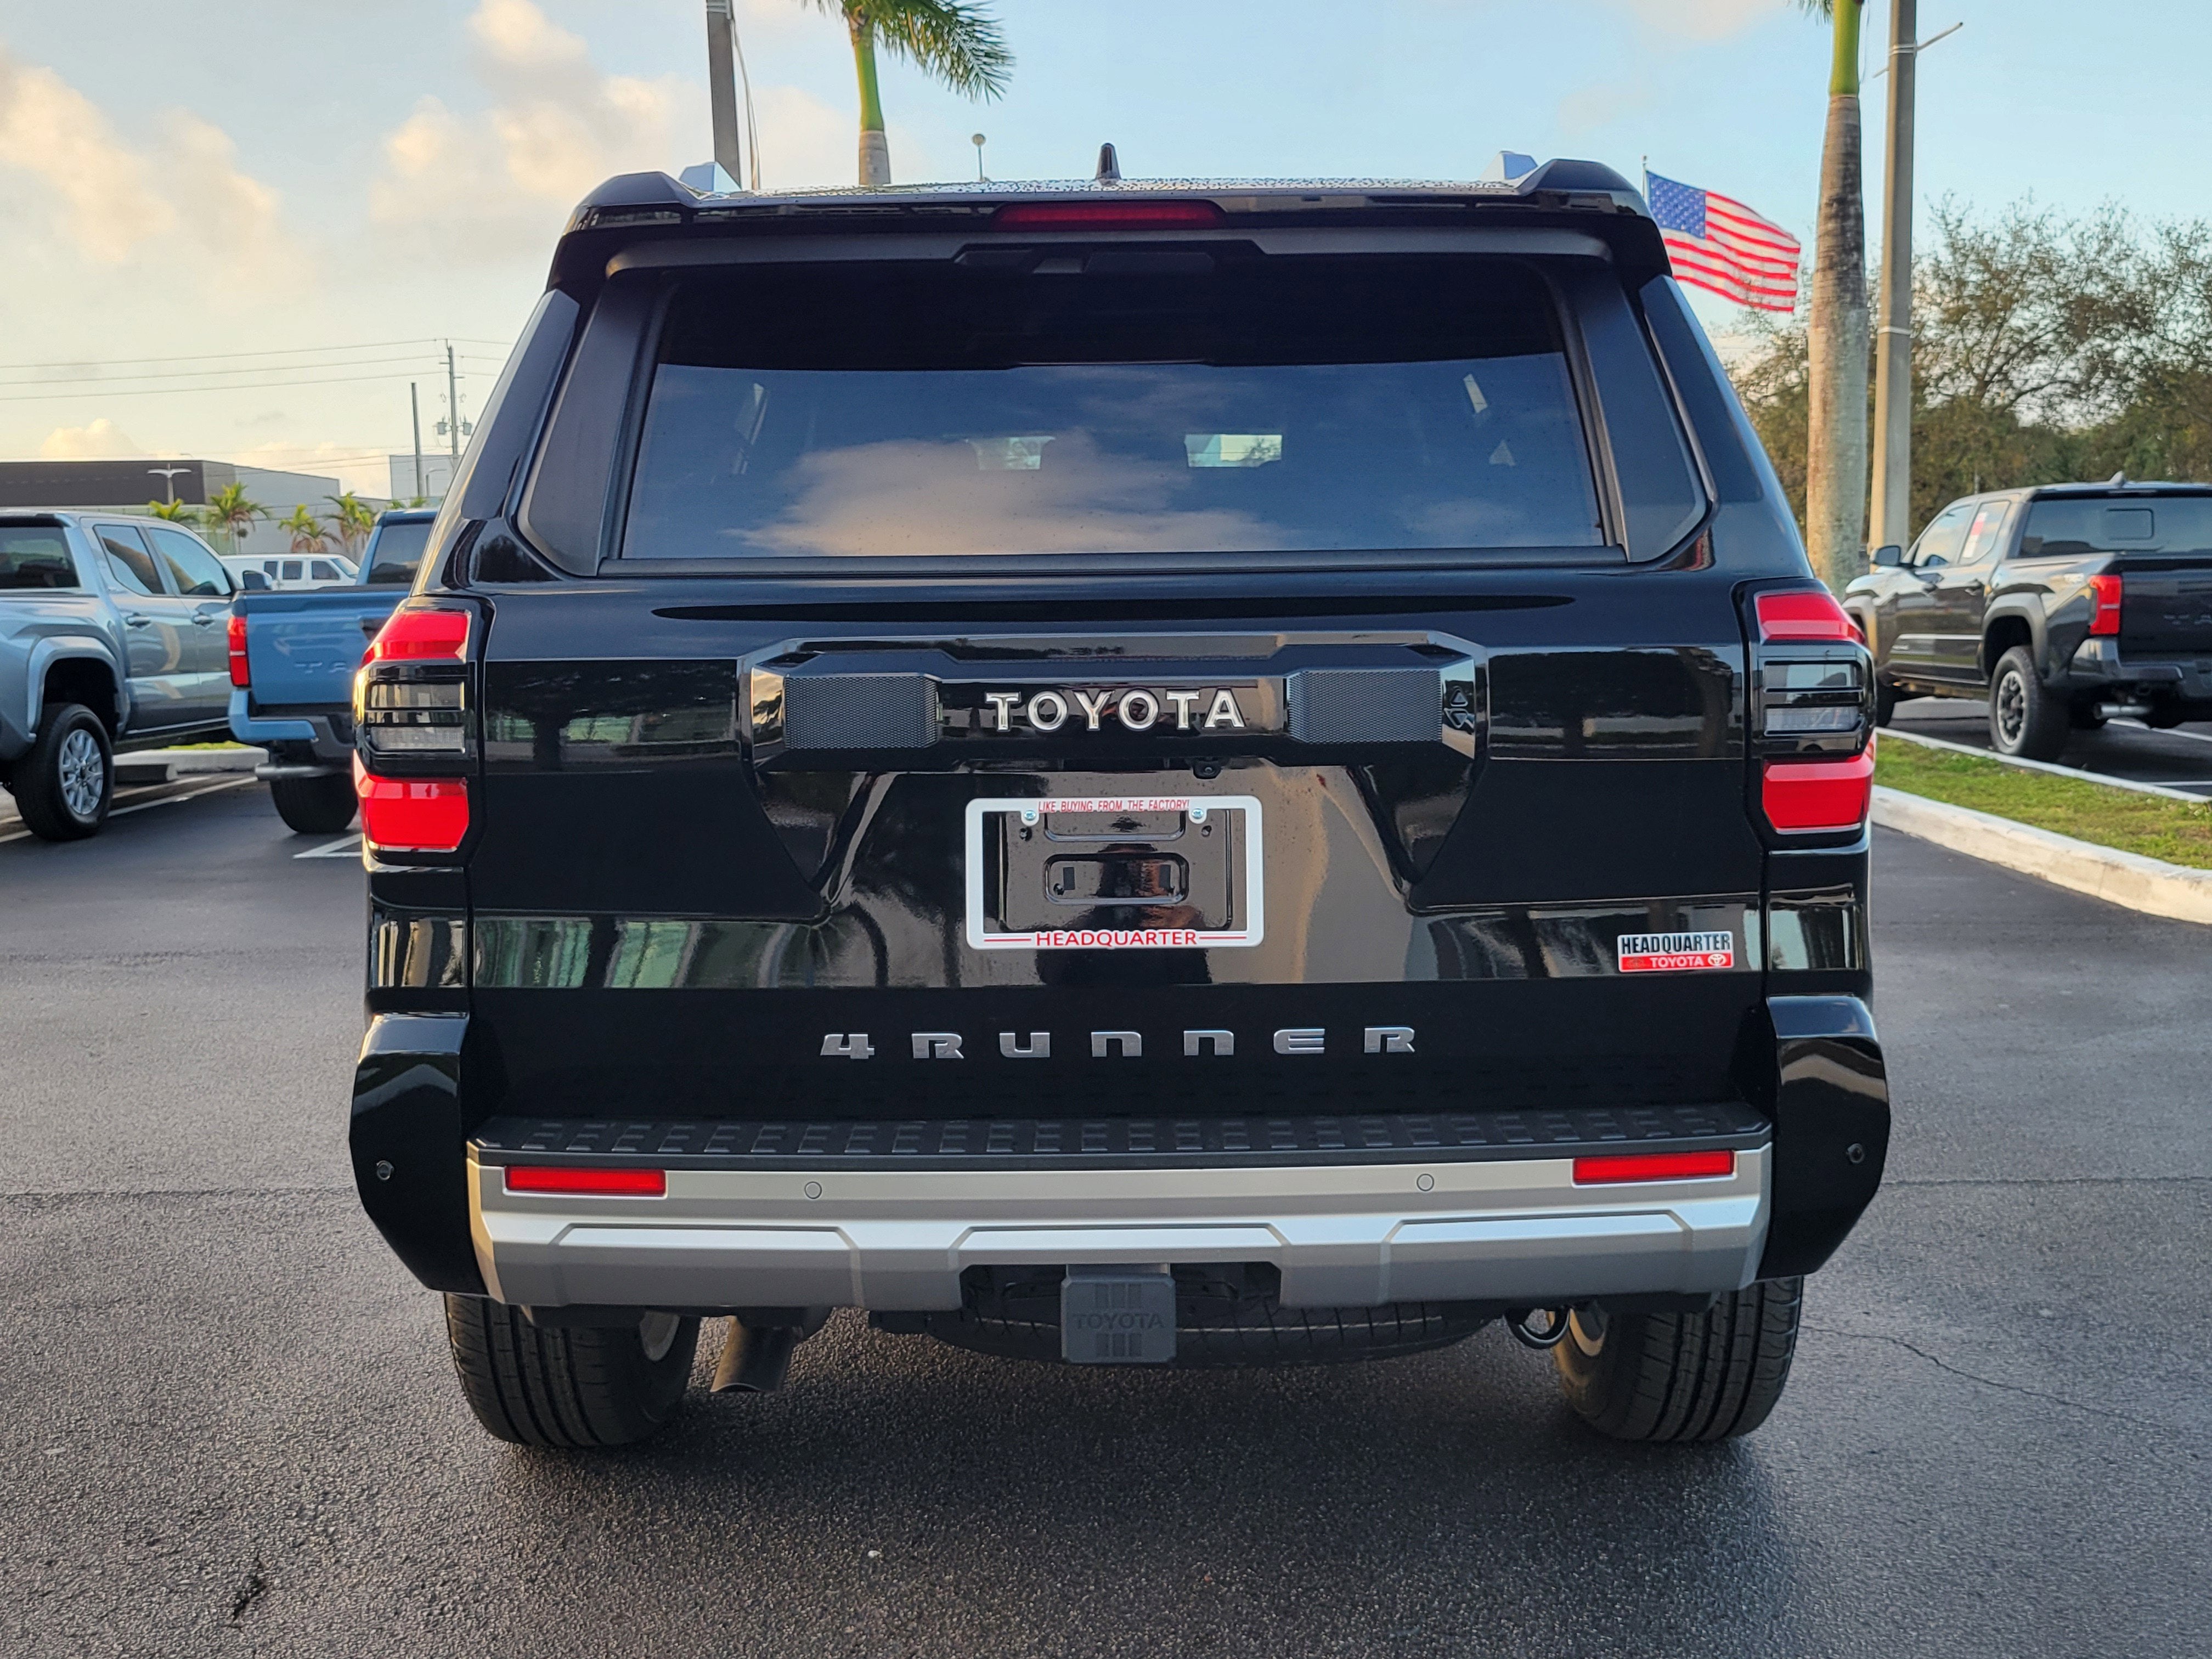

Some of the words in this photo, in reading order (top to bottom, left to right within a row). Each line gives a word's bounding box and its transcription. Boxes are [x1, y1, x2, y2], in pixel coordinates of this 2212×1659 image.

[985, 687, 1246, 732] TOYOTA
[1038, 801, 1057, 812] LIKE
[1061, 800, 1093, 812] BUYING
[1098, 800, 1123, 812] FROM
[1128, 800, 1143, 811] THE
[1148, 799, 1190, 811] FACTORY!
[1036, 932, 1197, 947] HEADQUARTER
[1622, 933, 1731, 954] HEADQUARTER
[1650, 956, 1705, 968] TOYOTA
[820, 1026, 1416, 1059] 4RUNNER
[1074, 1313, 1166, 1330] TOYOTA
